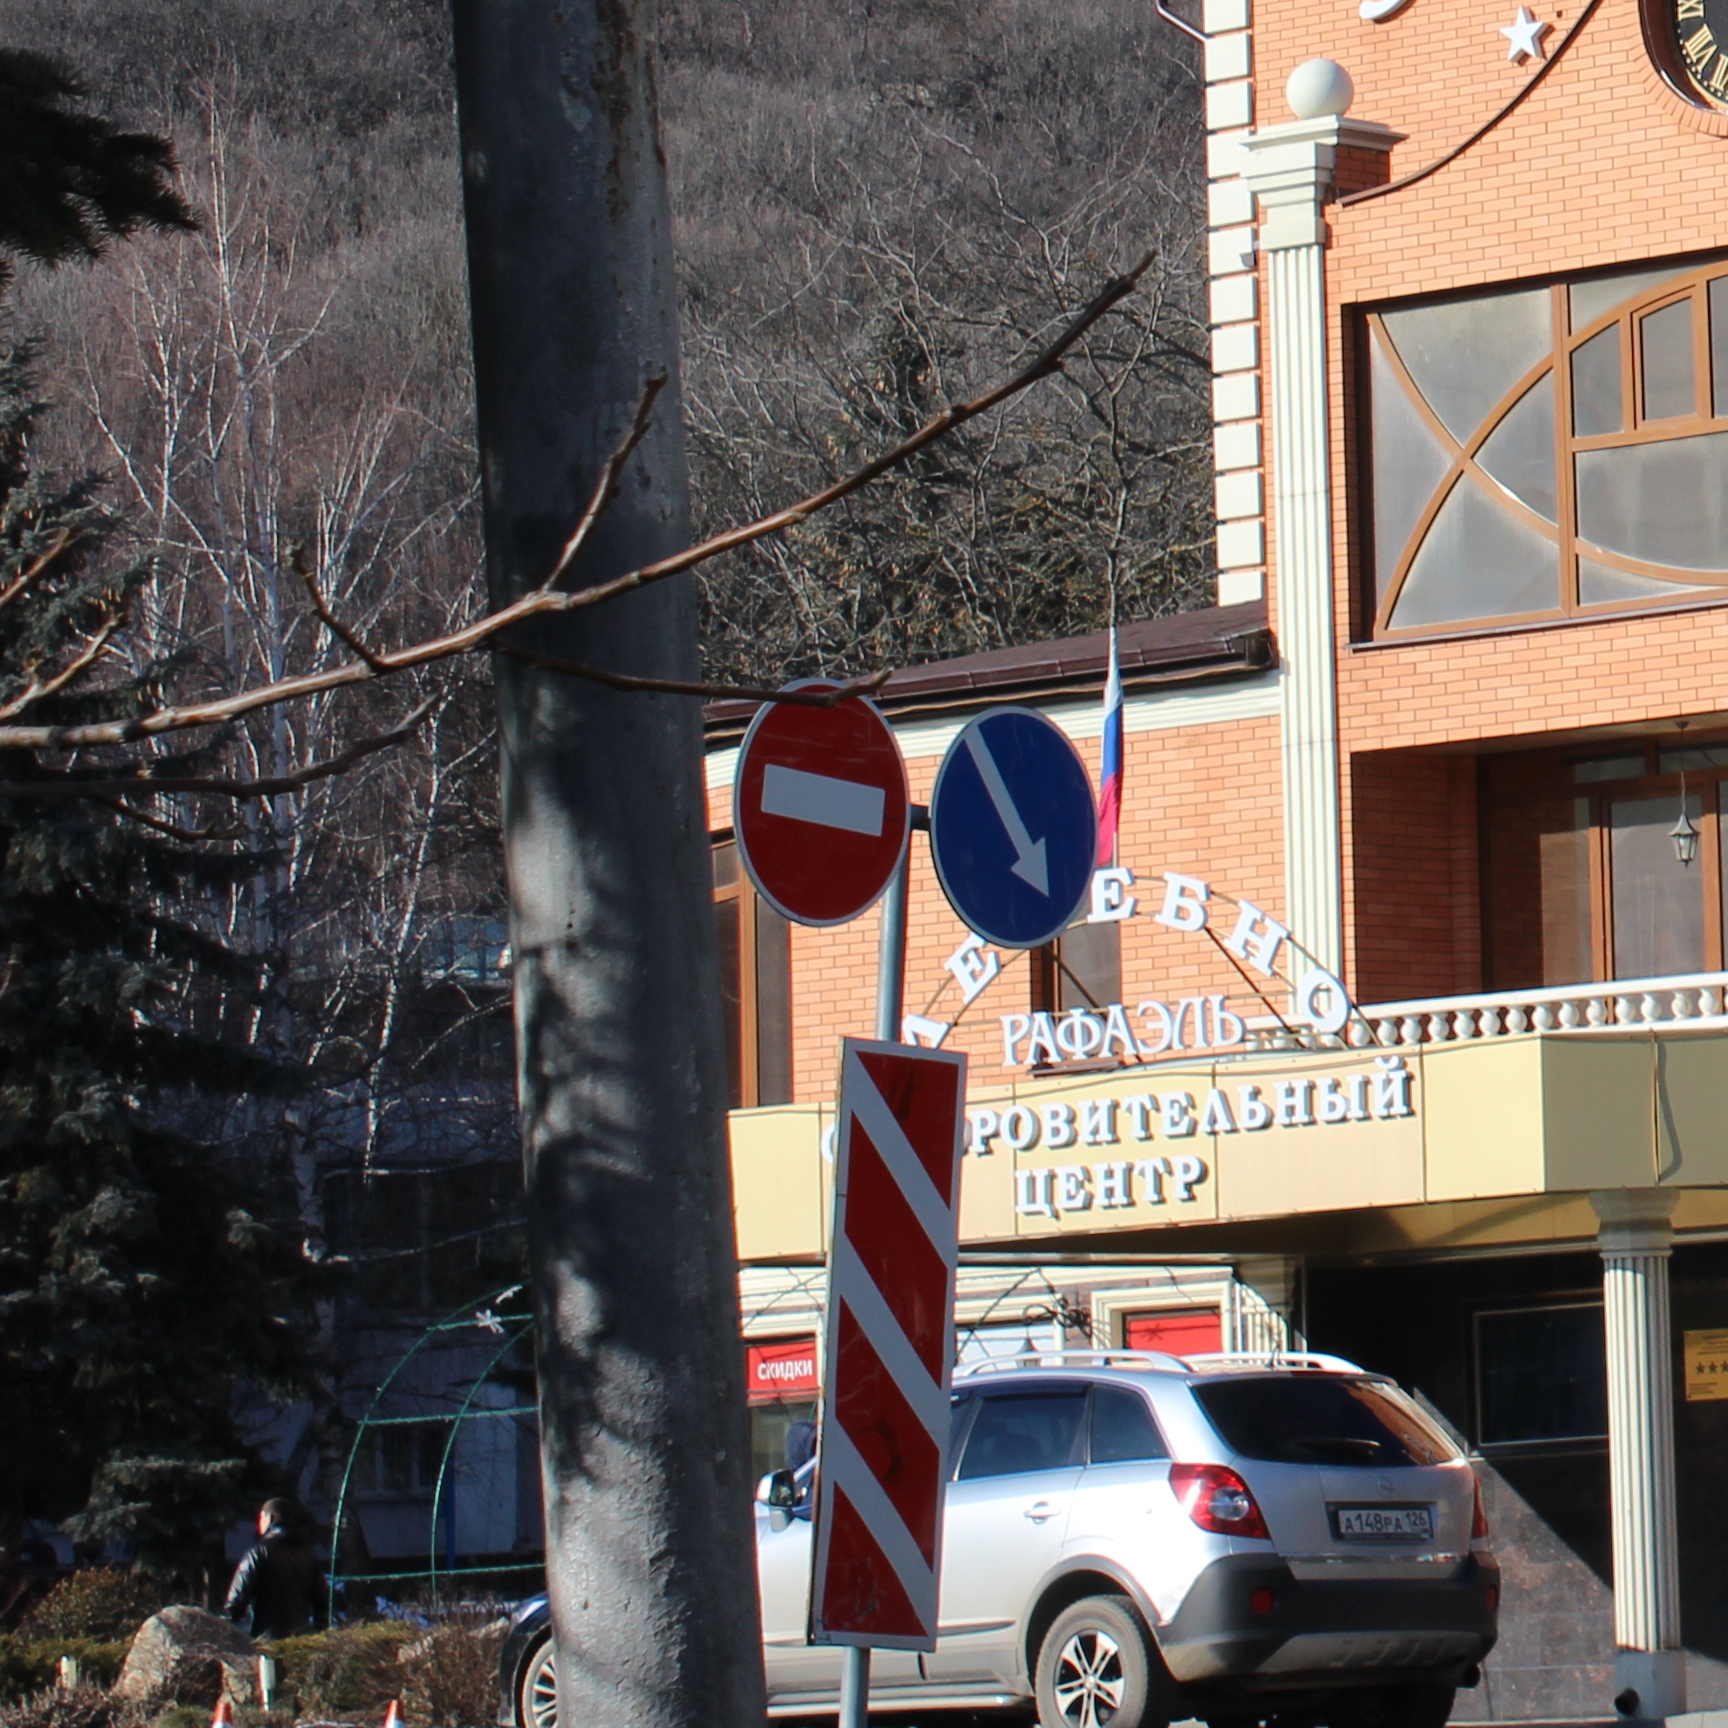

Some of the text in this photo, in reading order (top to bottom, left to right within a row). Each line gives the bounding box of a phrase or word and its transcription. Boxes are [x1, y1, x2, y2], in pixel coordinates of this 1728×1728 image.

[902, 866, 1351, 1048] ЛЕЕБНО
[1000, 994, 1245, 1066] РАФАЭЛЬ
[1014, 1153, 1209, 1221] ЦЕНТР
